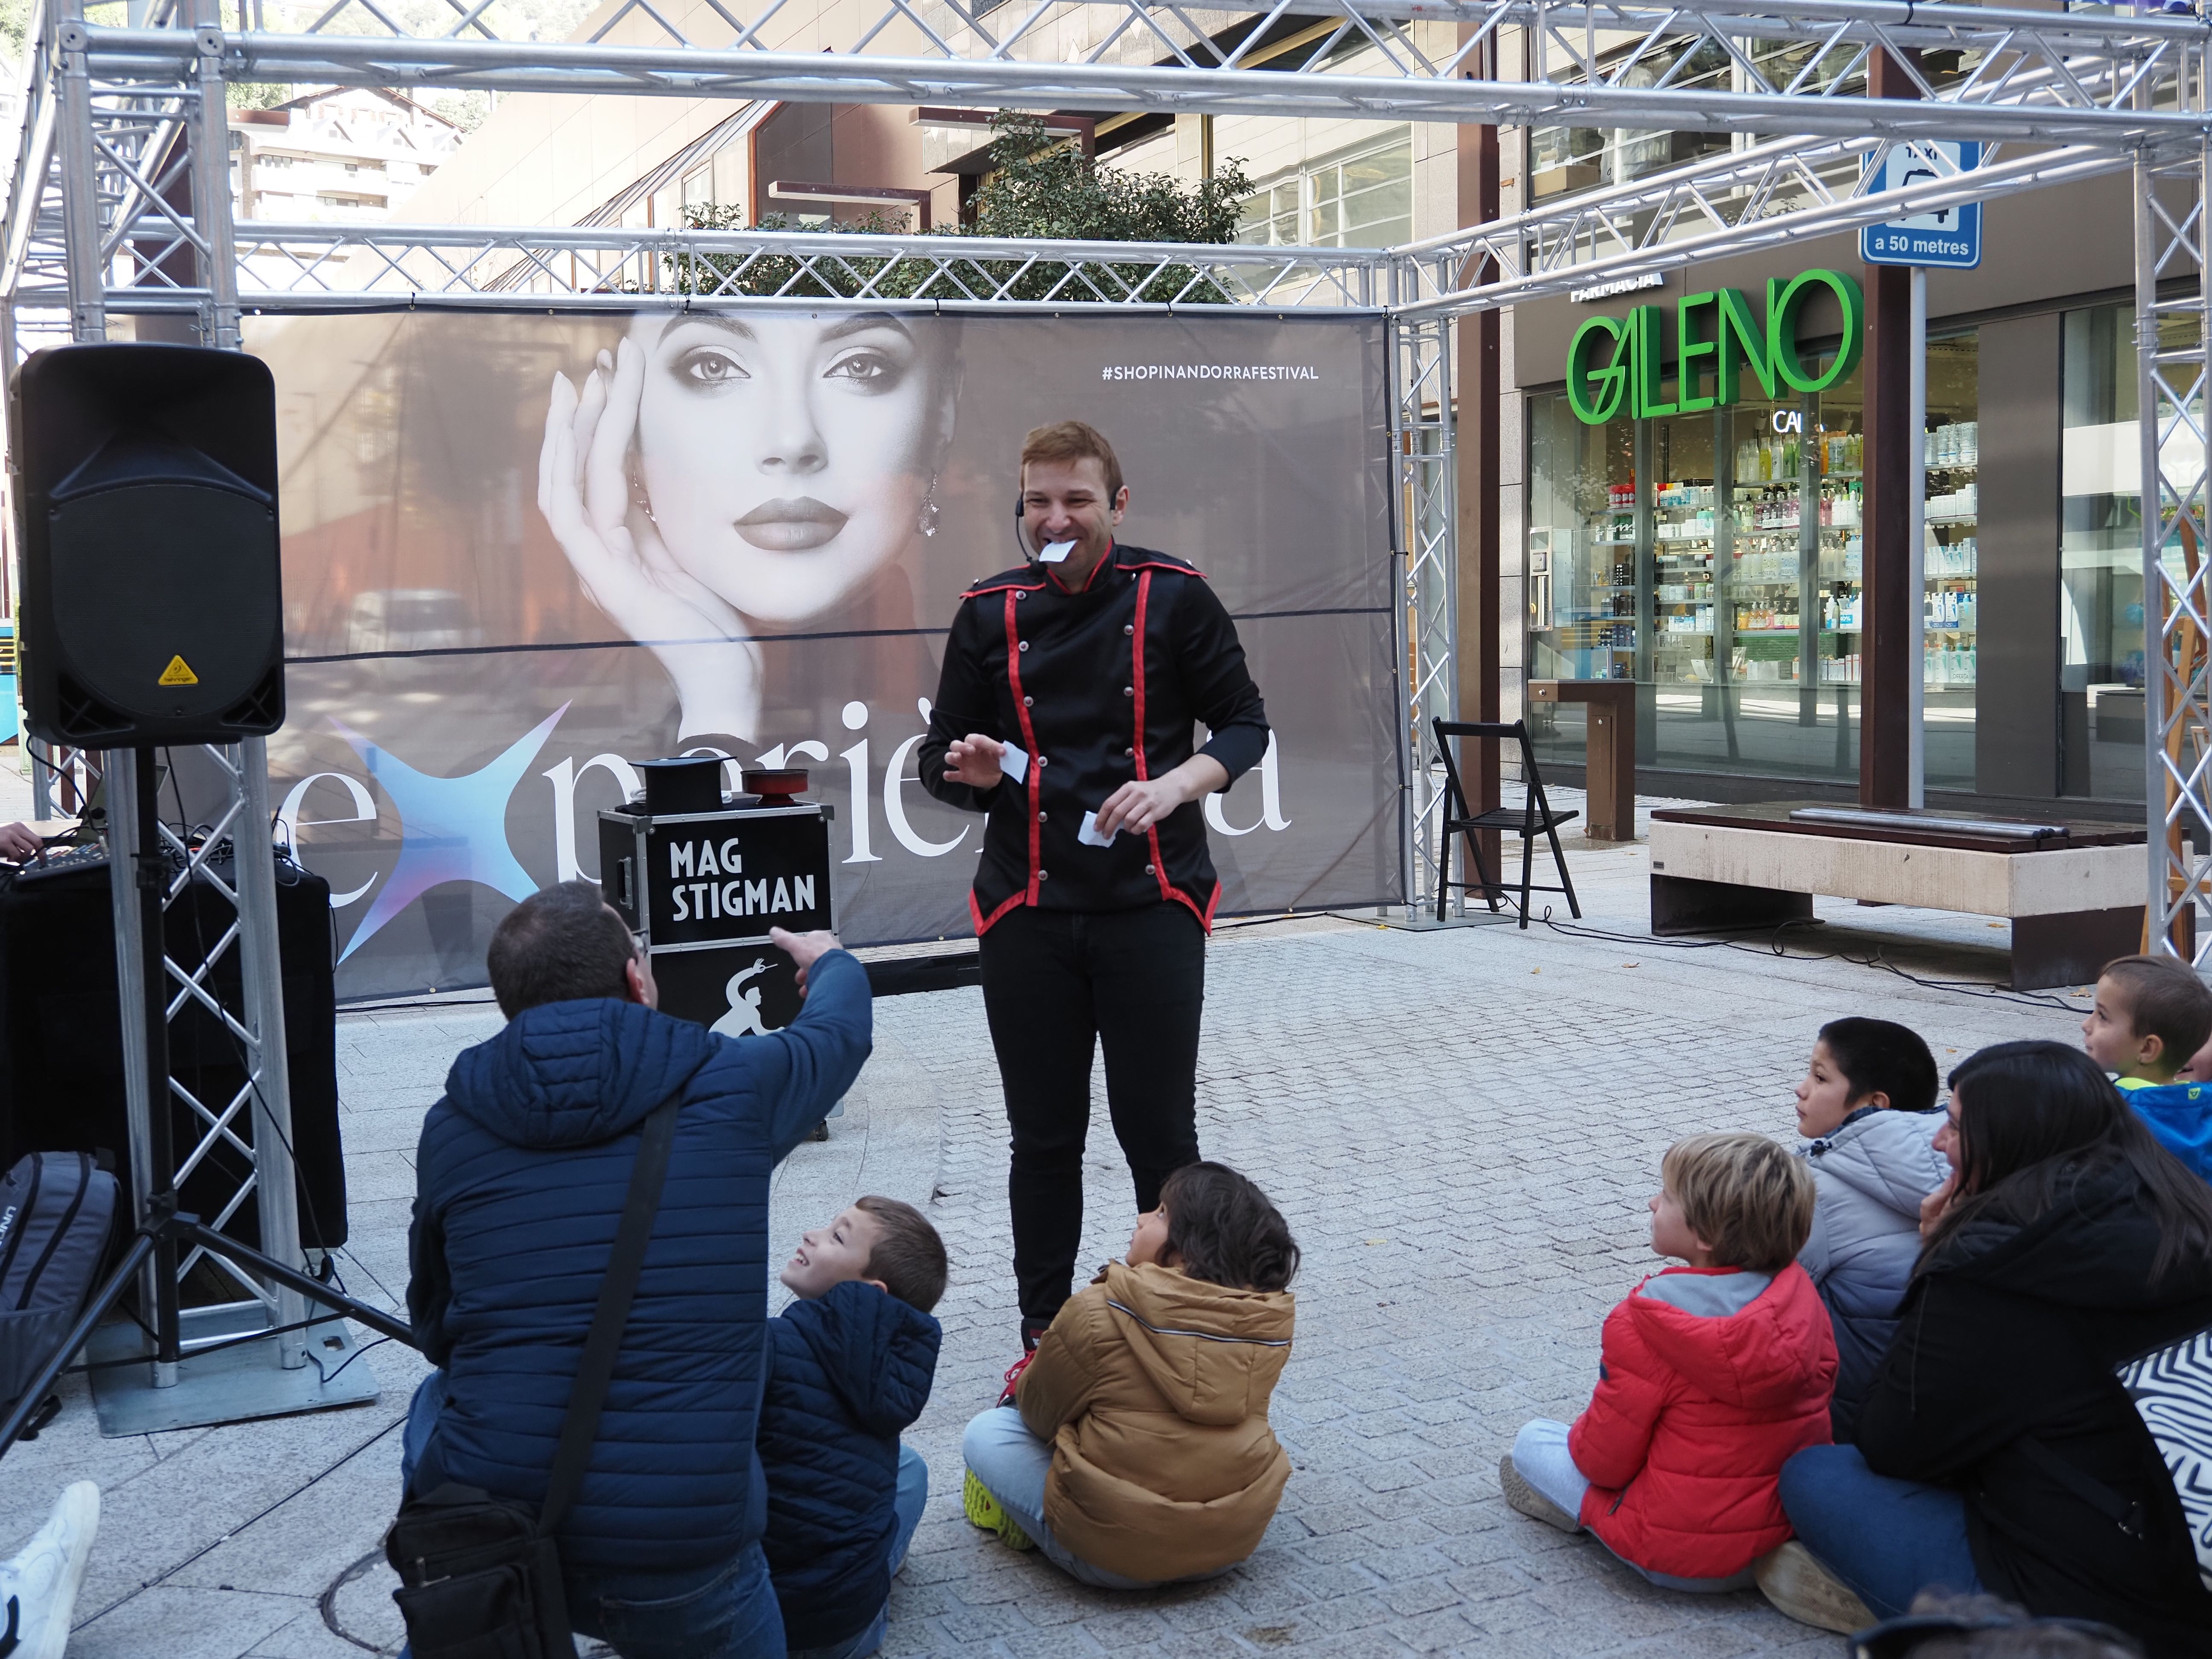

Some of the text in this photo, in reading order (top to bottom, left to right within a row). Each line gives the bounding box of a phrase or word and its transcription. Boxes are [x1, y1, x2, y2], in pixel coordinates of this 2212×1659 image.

[1875, 236, 1969, 256] a 50 metres
[1566, 268, 1863, 425] GALENO
[1102, 365, 1319, 380] #SHOPINANDORRAFESTIVAL
[669, 837, 742, 879] MAG
[672, 874, 815, 921] STIGMAN
